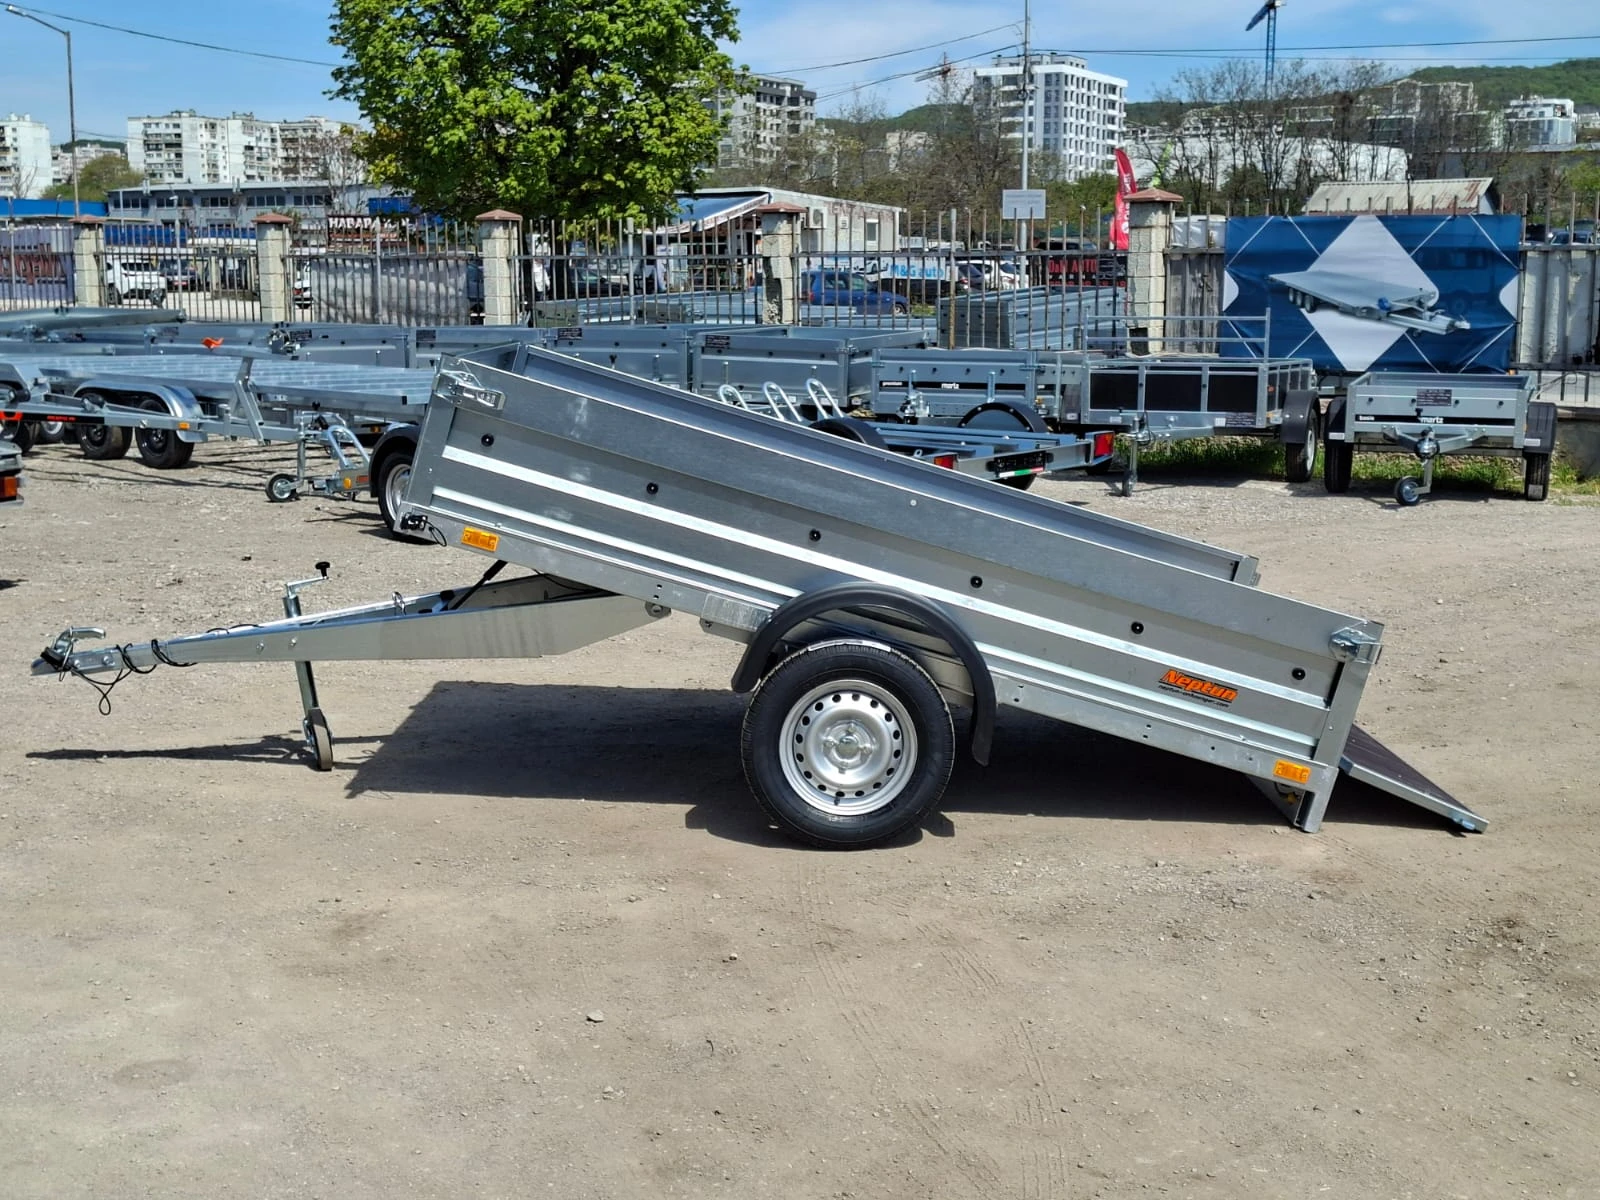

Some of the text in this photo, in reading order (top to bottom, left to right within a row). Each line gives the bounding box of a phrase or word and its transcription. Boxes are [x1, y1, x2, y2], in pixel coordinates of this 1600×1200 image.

[889, 264, 945, 278] M&G auto
[1160, 669, 1238, 702] Neptun
